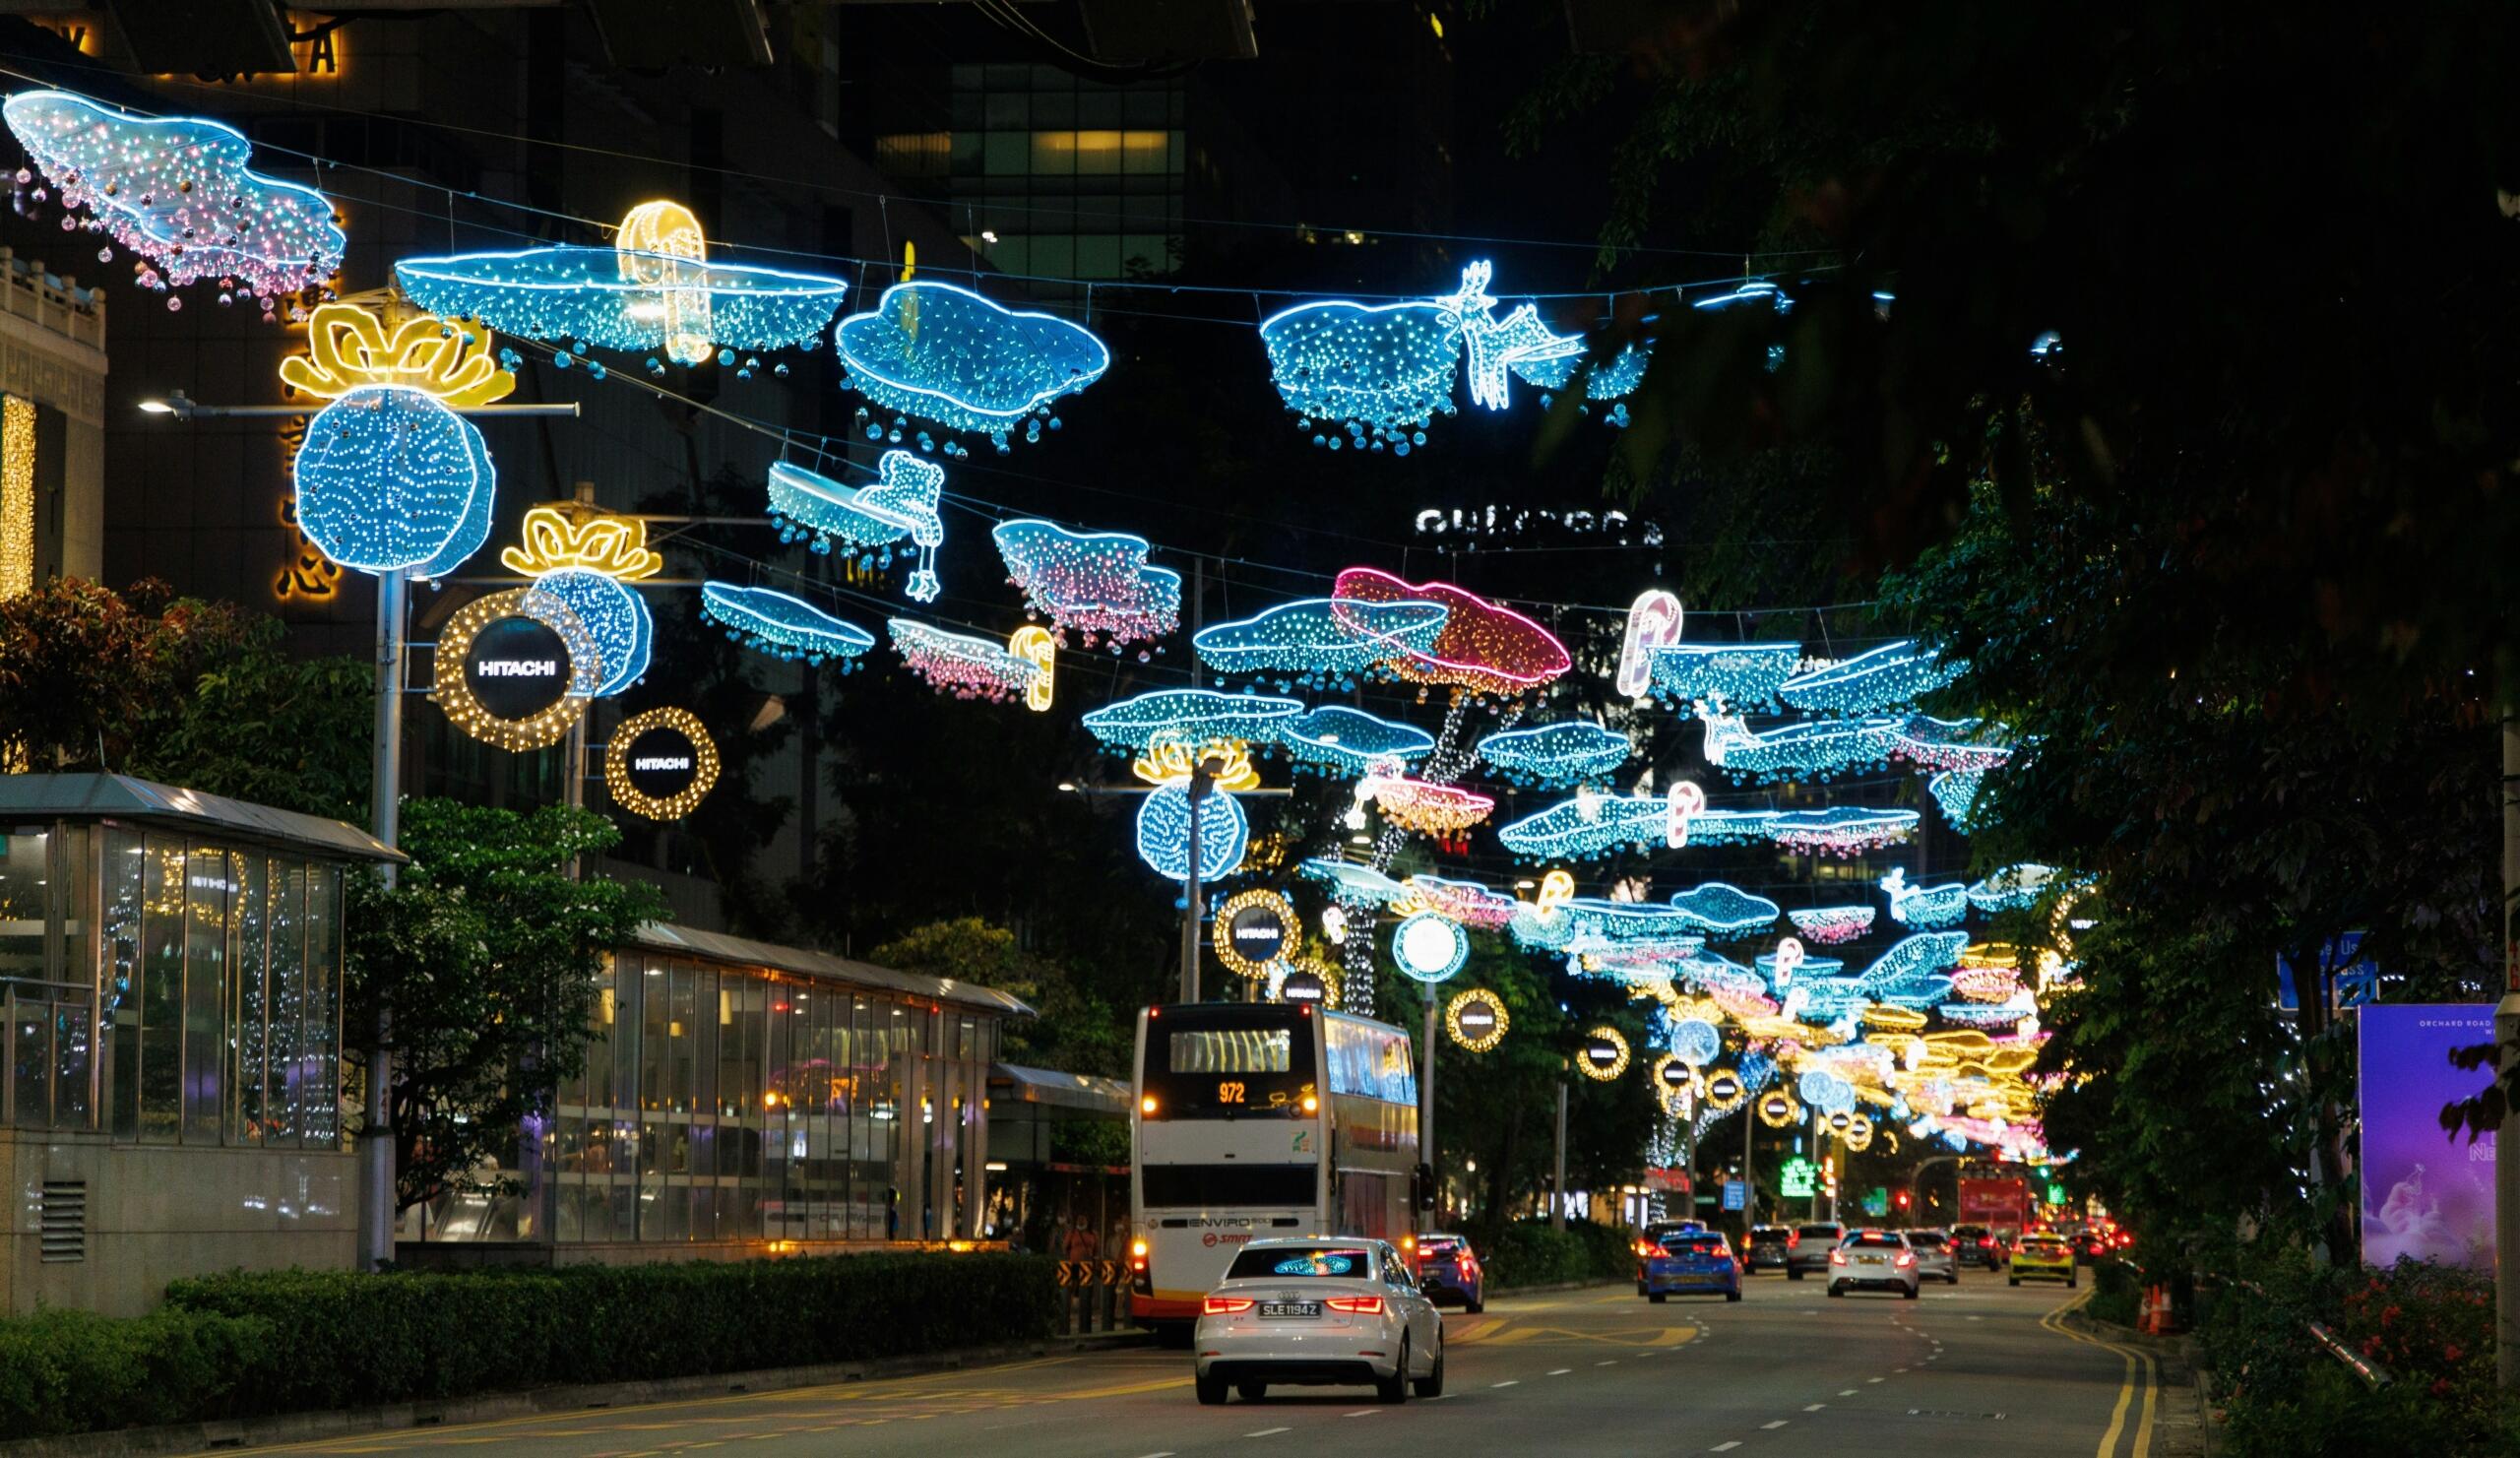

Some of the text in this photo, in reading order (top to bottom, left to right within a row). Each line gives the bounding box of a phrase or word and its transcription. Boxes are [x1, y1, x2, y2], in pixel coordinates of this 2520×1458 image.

[477, 661, 555, 676] HITACHI
[635, 757, 689, 770] HITACHI
[1219, 1082, 1244, 1103] 972
[1219, 1234, 1253, 1244] SMRT
